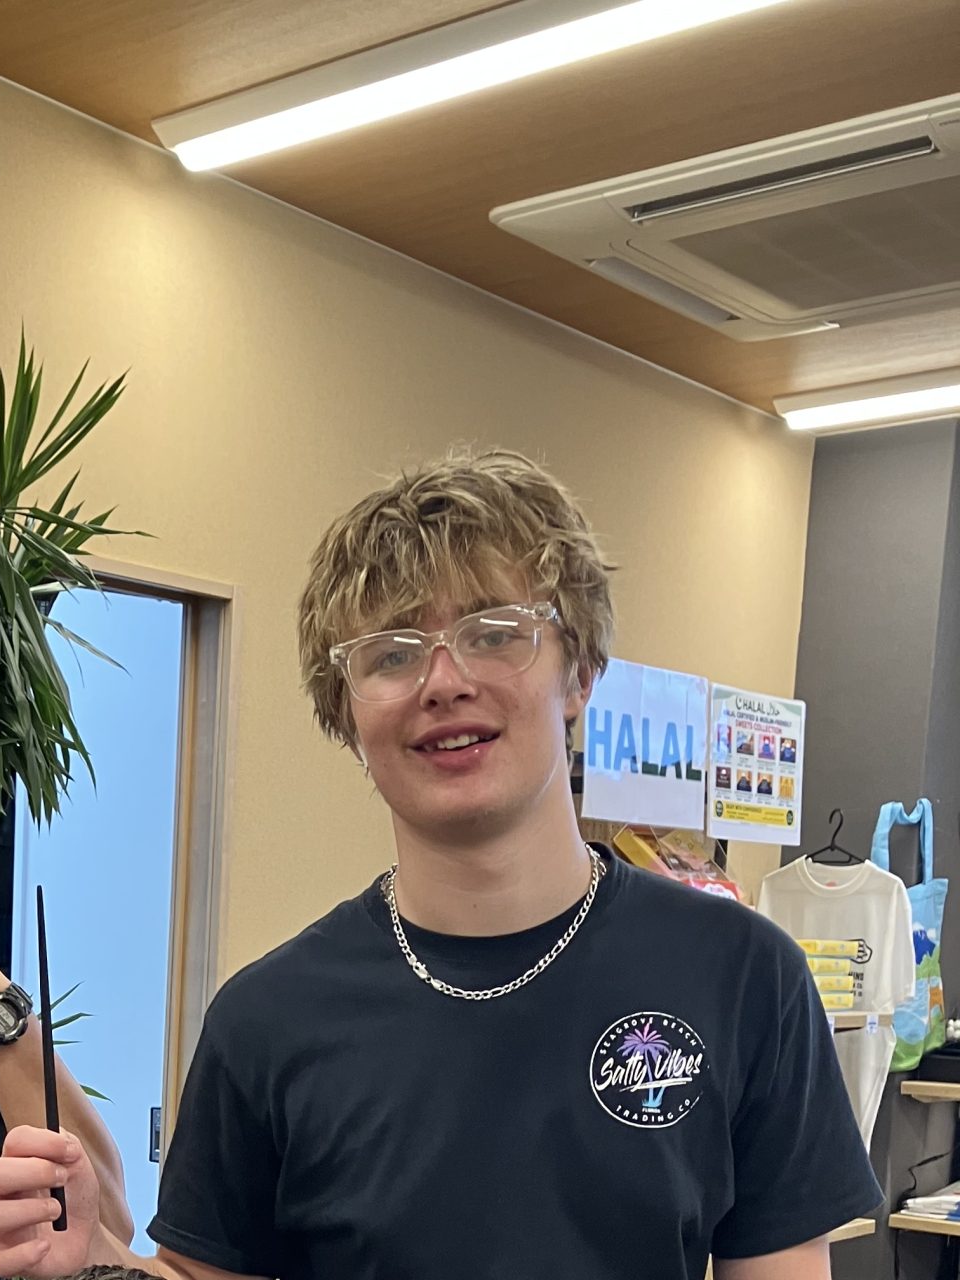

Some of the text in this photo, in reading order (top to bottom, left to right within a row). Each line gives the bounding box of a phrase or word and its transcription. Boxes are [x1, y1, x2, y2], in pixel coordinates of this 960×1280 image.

[588, 706, 702, 782] HALAL
[600, 1016, 697, 1055] SEAGROVE BEACH
[654, 1048, 703, 1080] Vibes
[616, 1105, 674, 1123] TRADING
